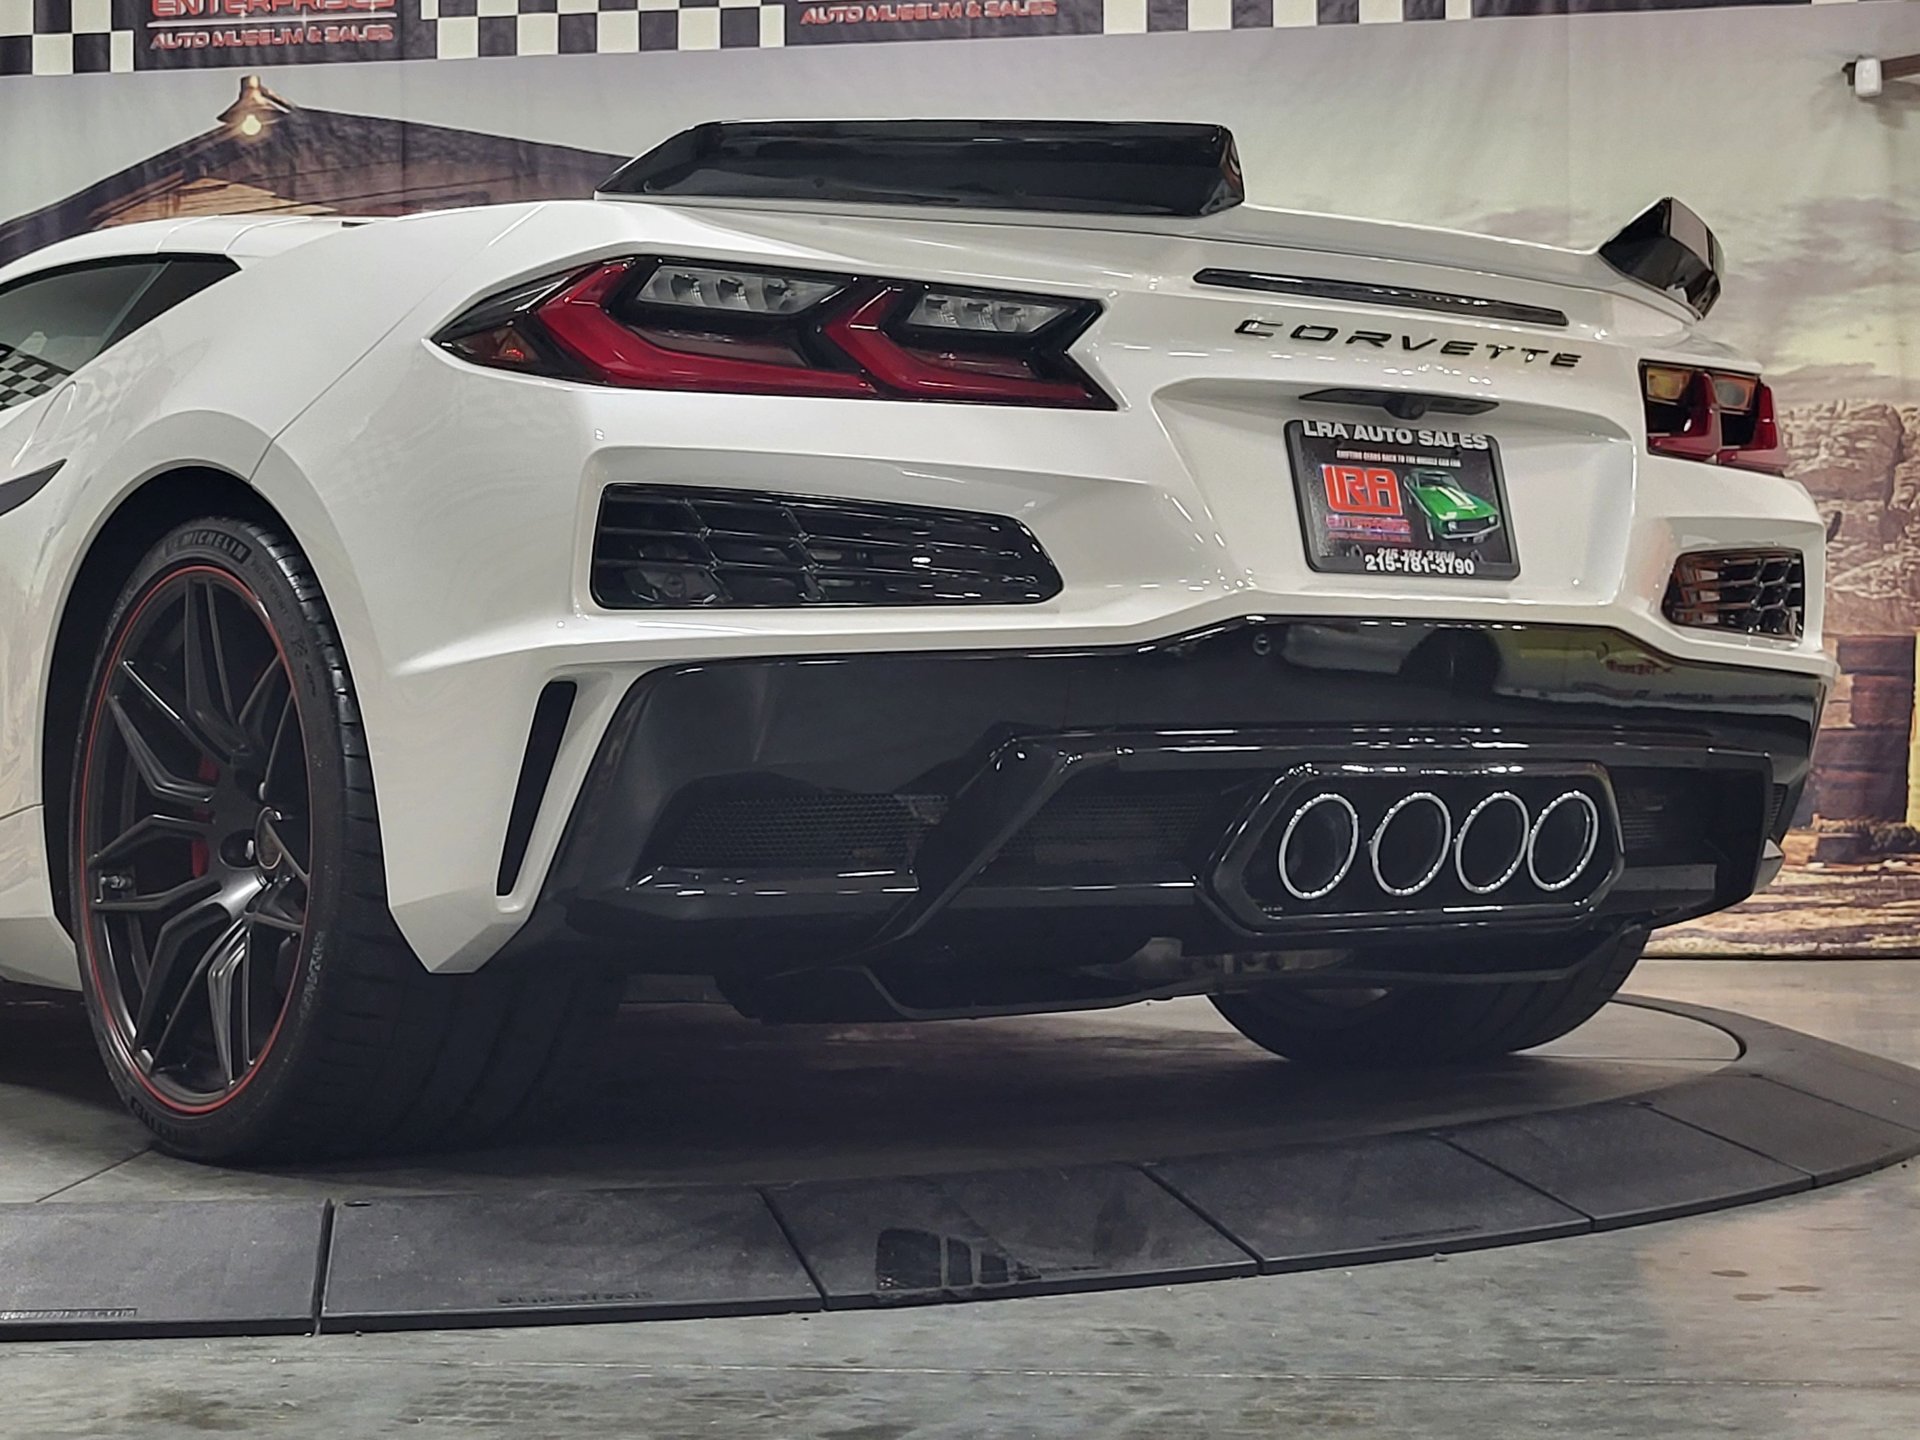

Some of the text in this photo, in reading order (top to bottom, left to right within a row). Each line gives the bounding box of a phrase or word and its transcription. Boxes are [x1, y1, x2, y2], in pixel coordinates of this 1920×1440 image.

[800, 0, 1058, 24] AUTO MUSEUM & SALES
[150, 24, 394, 50] AUTO MUSEUM & SALES
[1234, 319, 1582, 368] CORVETTE
[1302, 420, 1489, 450] LRA AUTO SALES
[1322, 464, 1404, 516] LRA
[182, 531, 249, 560] MICHELIN
[1364, 554, 1475, 575] 215-781-3790
